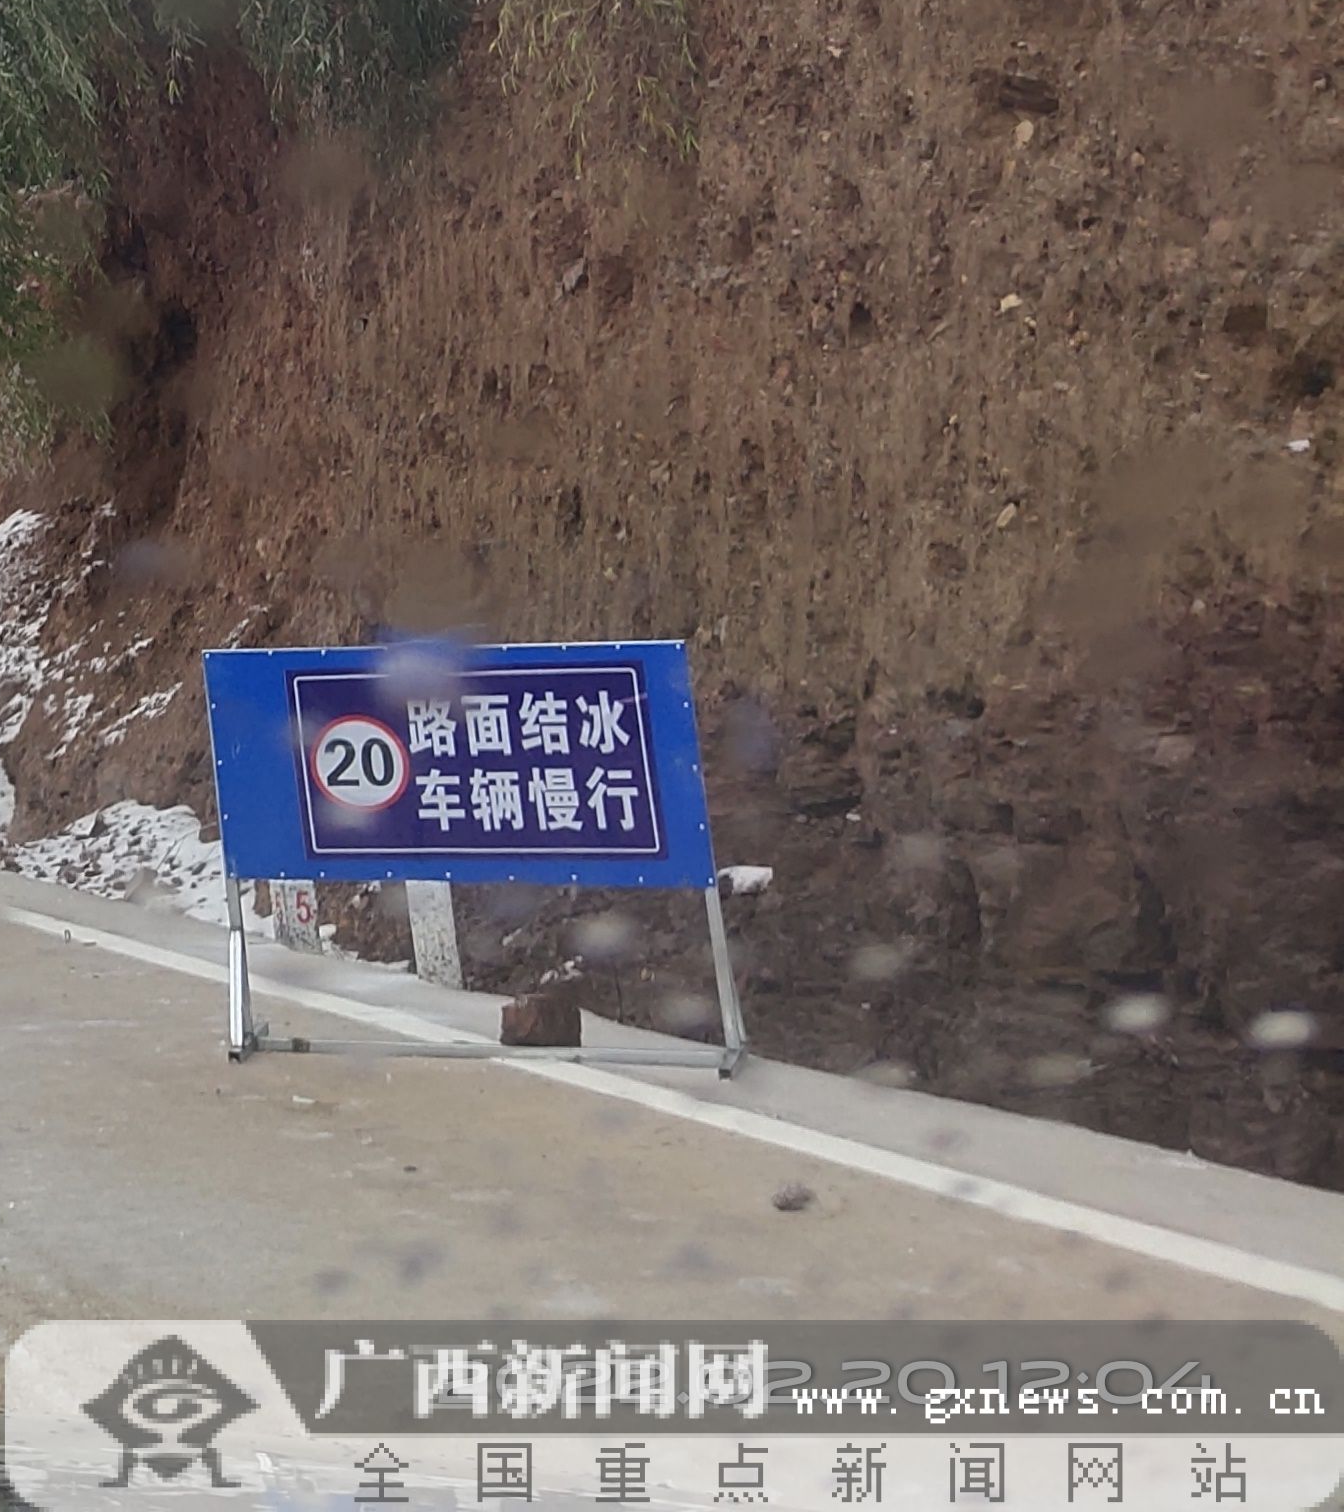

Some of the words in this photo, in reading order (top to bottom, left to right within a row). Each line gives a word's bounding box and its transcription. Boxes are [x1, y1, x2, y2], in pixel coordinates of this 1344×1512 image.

[406, 691, 631, 756] 路面结冰
[325, 737, 395, 787] 20
[416, 767, 639, 831] 车辆慢行
